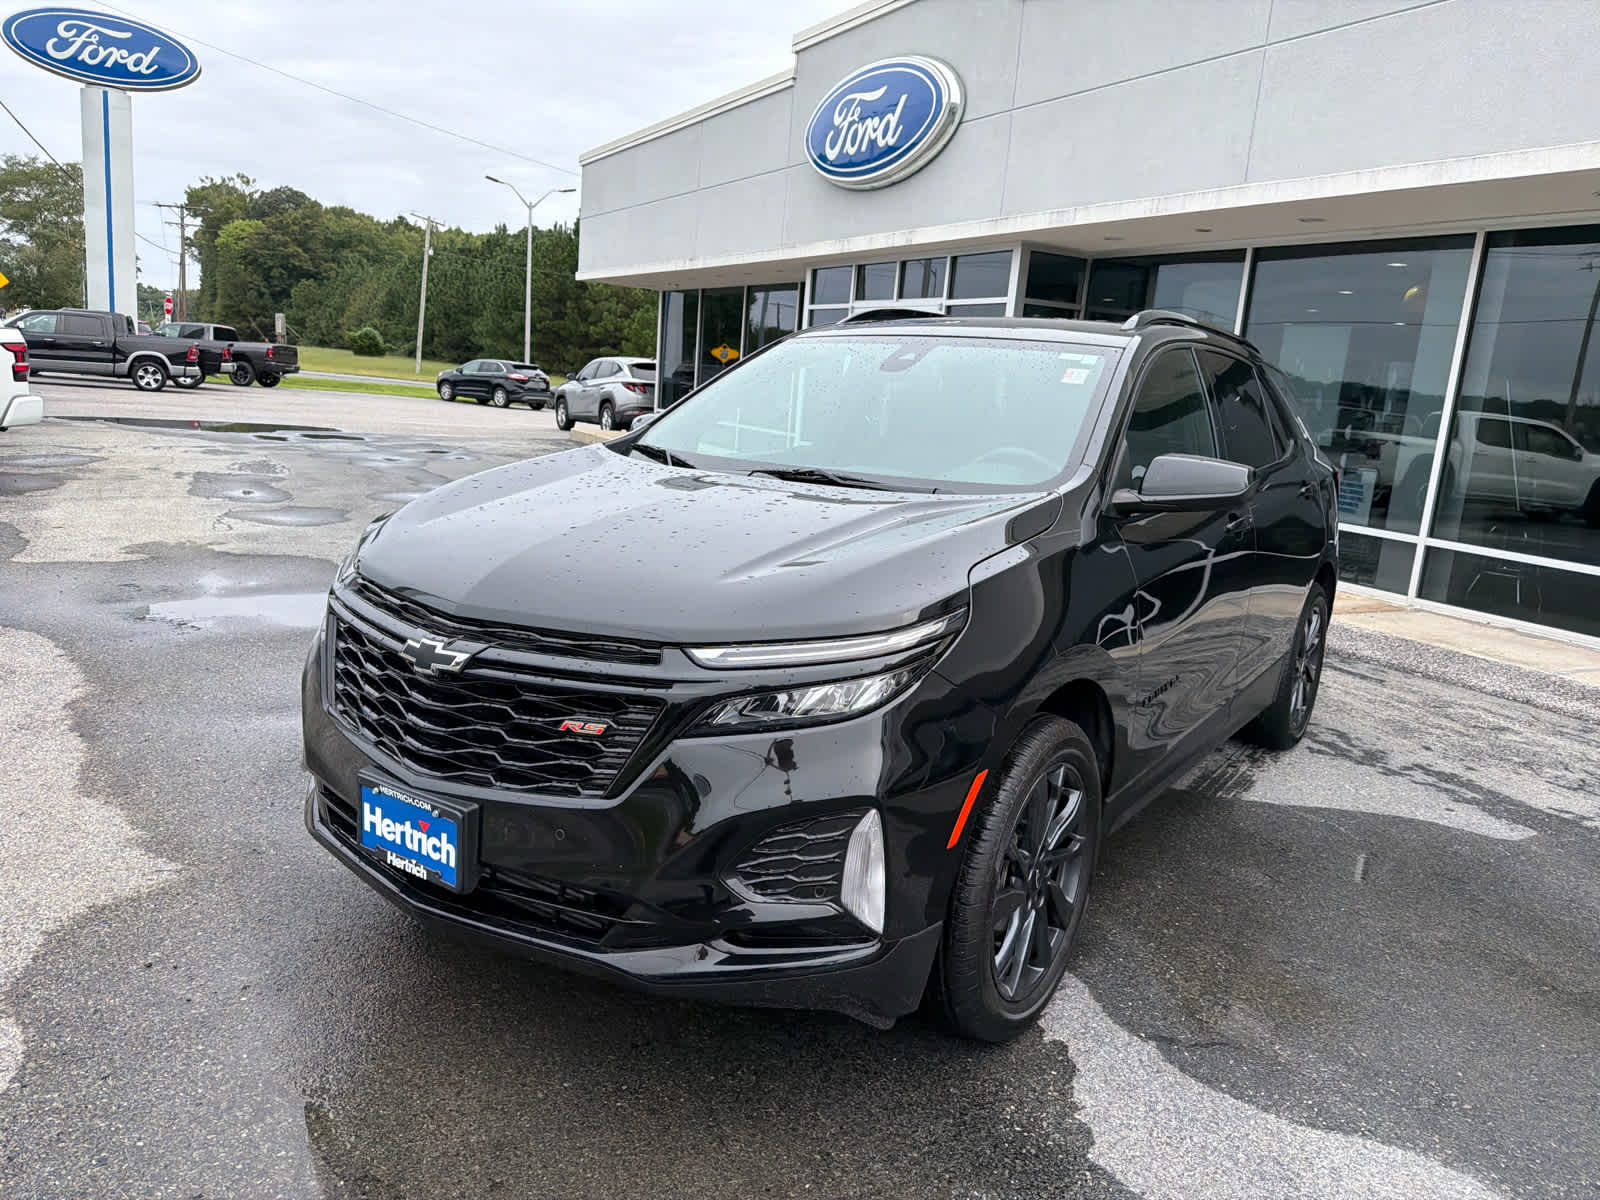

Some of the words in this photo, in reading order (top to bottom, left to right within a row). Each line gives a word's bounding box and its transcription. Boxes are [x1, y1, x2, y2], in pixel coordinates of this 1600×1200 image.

[46, 20, 160, 75] Ford
[825, 85, 908, 161] Ford
[560, 720, 607, 735] RS
[379, 784, 432, 812] HERTRICH.COM
[363, 802, 456, 868] Hertrich
[387, 851, 427, 880] Hertrich
